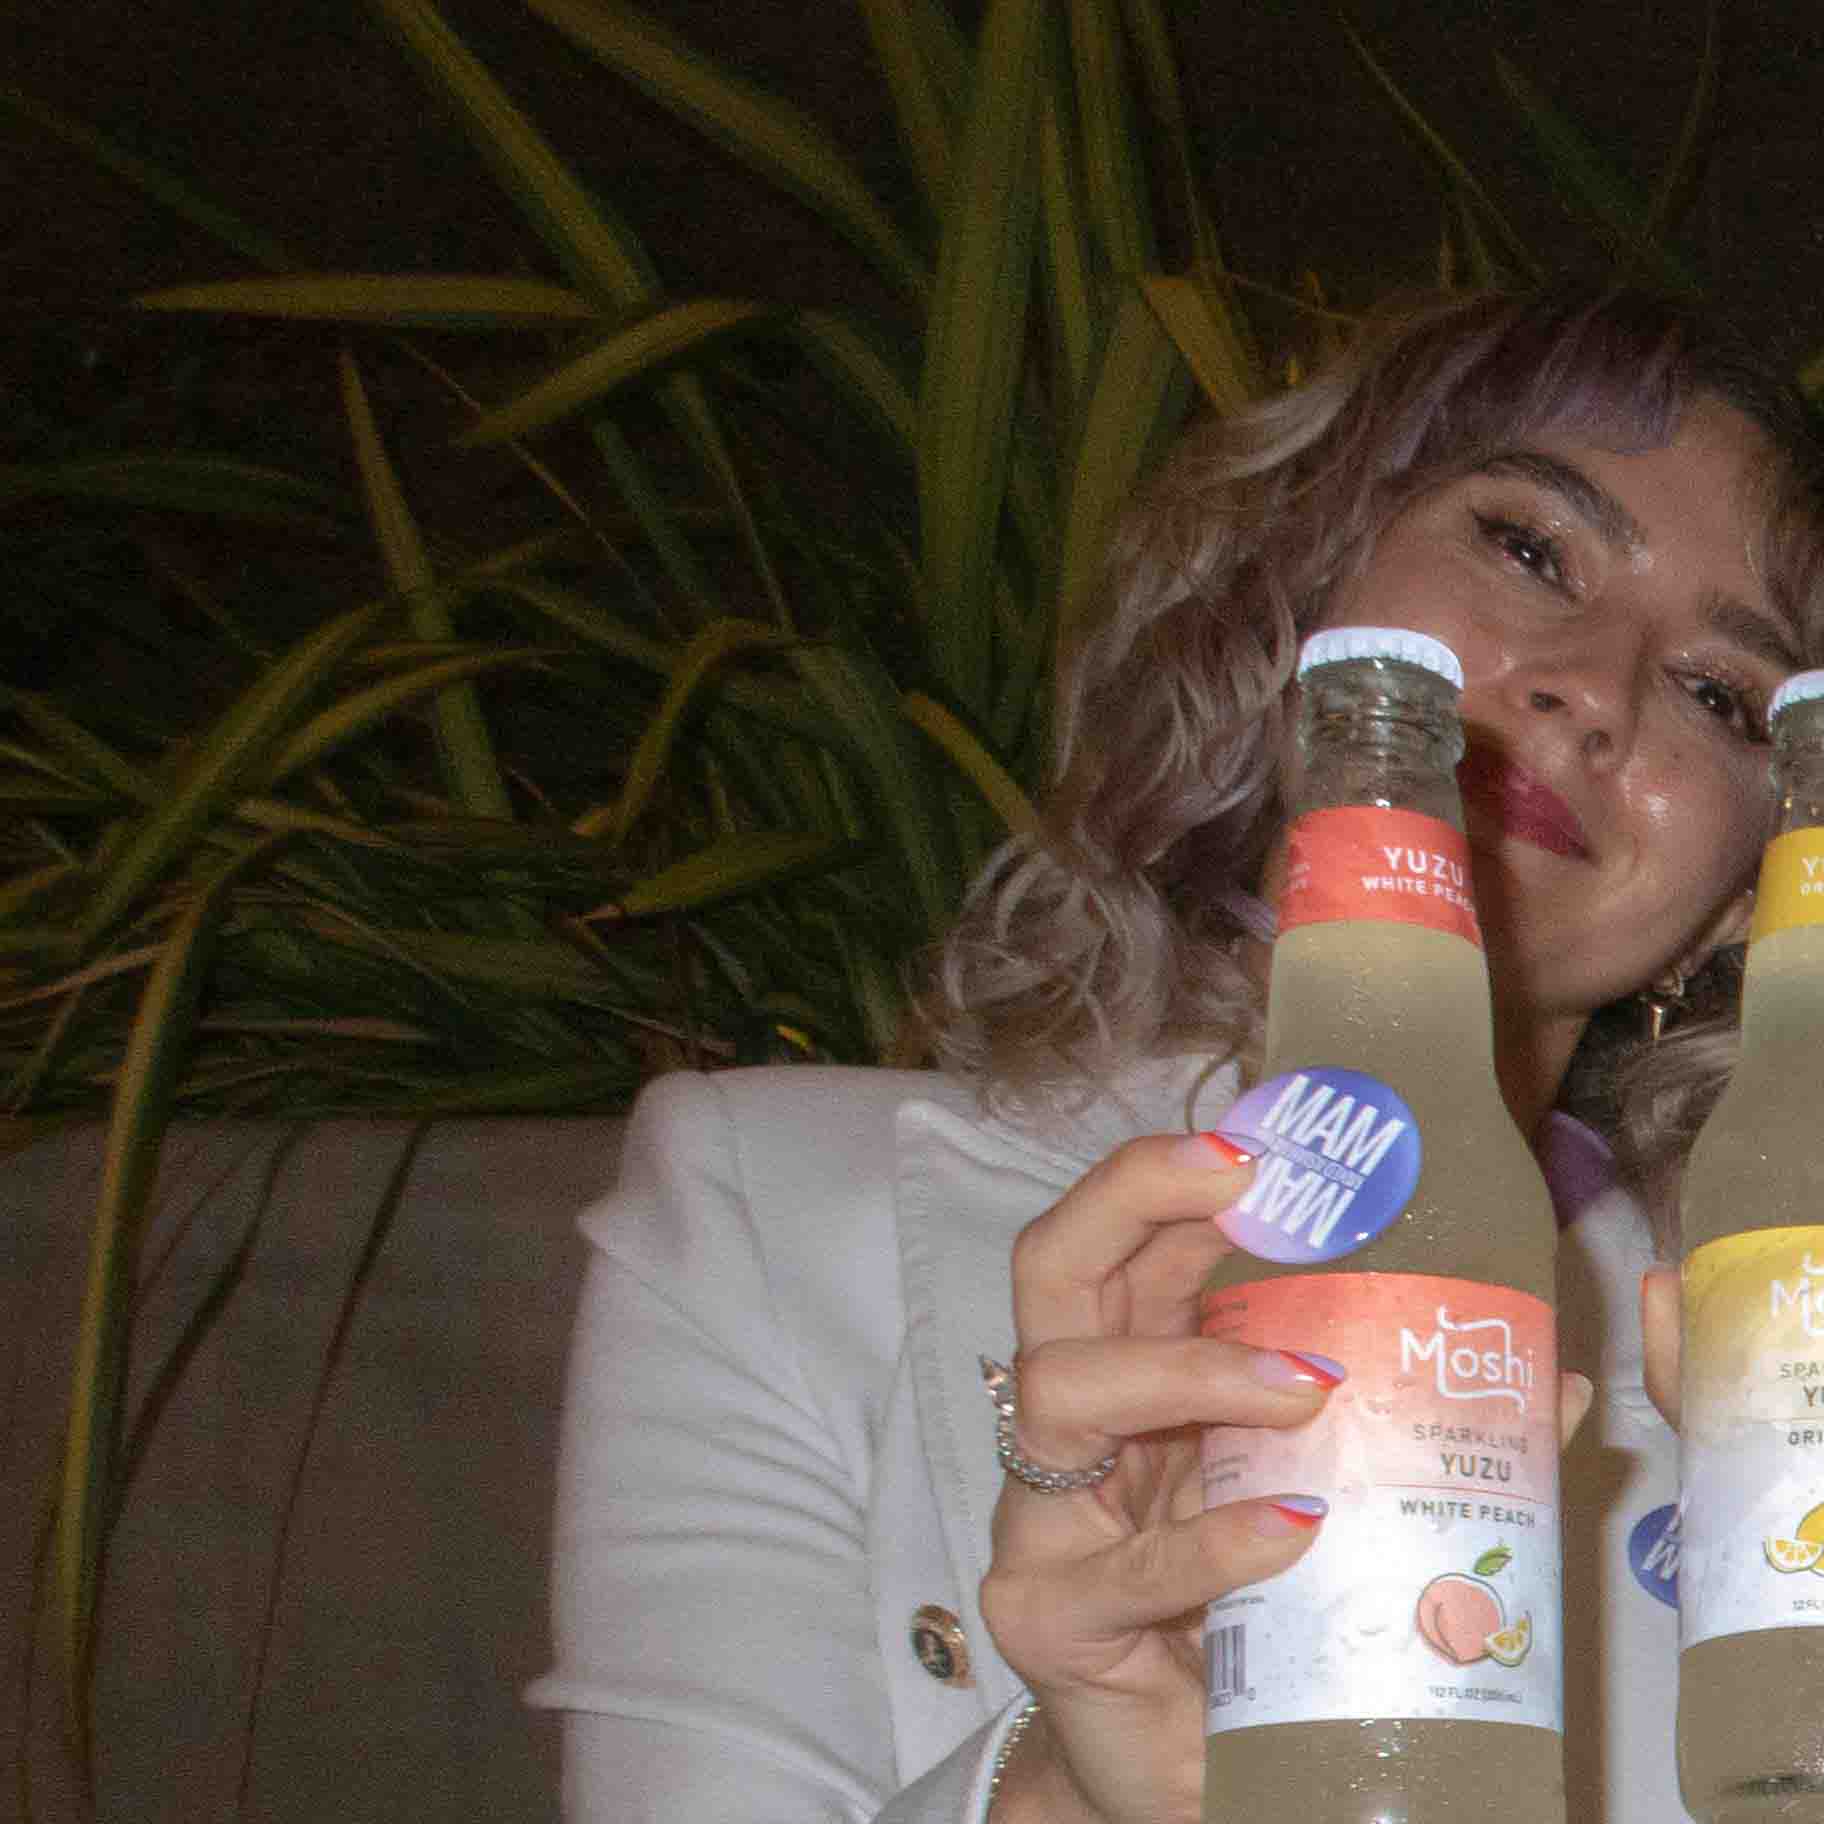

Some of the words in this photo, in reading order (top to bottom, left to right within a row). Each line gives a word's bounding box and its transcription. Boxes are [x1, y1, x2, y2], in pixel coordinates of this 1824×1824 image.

[1383, 846, 1464, 886] YUZU
[1361, 876, 1426, 895] WHITE
[1260, 1073, 1406, 1176] MAM
[1400, 1304, 1538, 1414] Moshi
[1413, 1423, 1528, 1453] SPARKLING
[1440, 1453, 1512, 1481] YUZU
[1400, 1498, 1473, 1519] WHITE
[1479, 1504, 1536, 1528] PEACH
